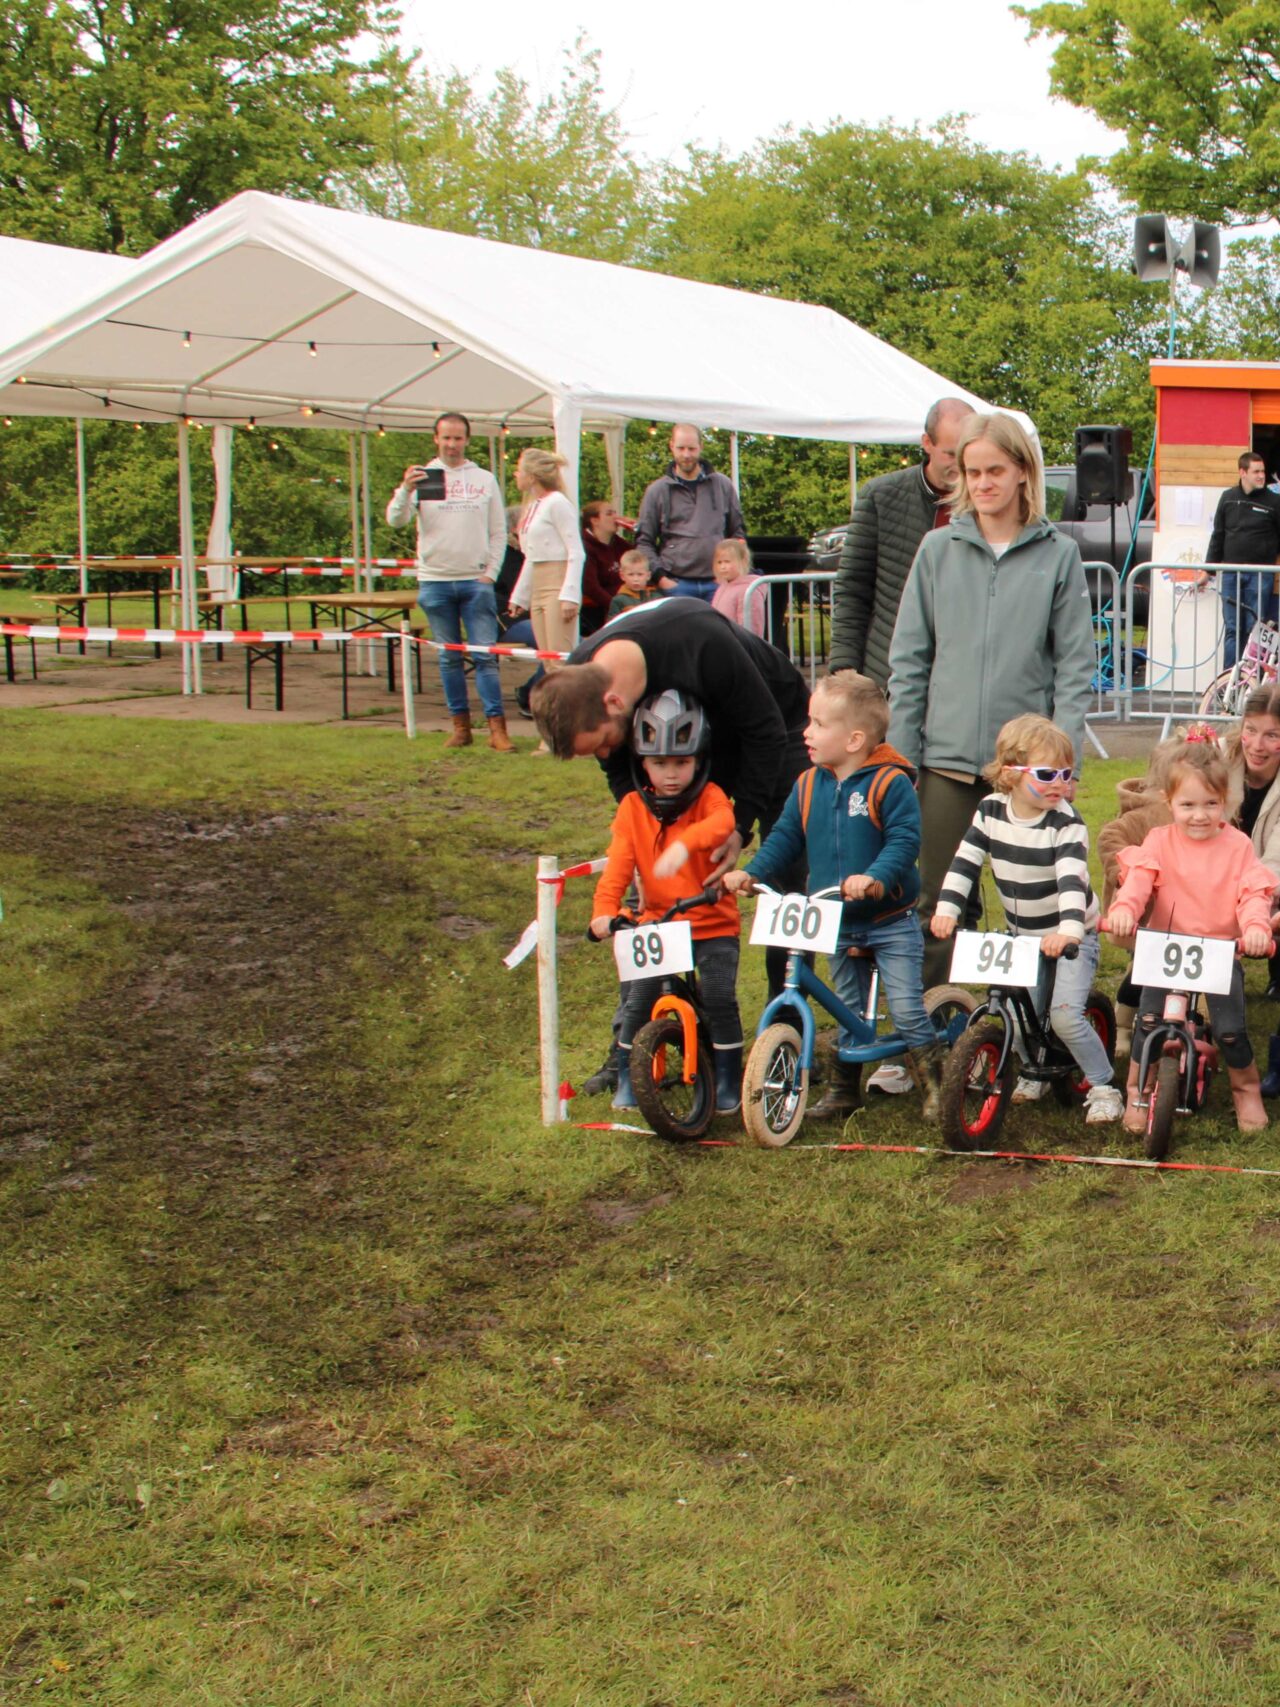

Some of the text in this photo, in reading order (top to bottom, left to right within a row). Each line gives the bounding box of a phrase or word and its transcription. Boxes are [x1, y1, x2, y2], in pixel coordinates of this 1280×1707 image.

[769, 903, 822, 940] 160
[632, 932, 664, 969] 89
[977, 940, 1013, 974] 94
[1163, 942, 1204, 980] 93
